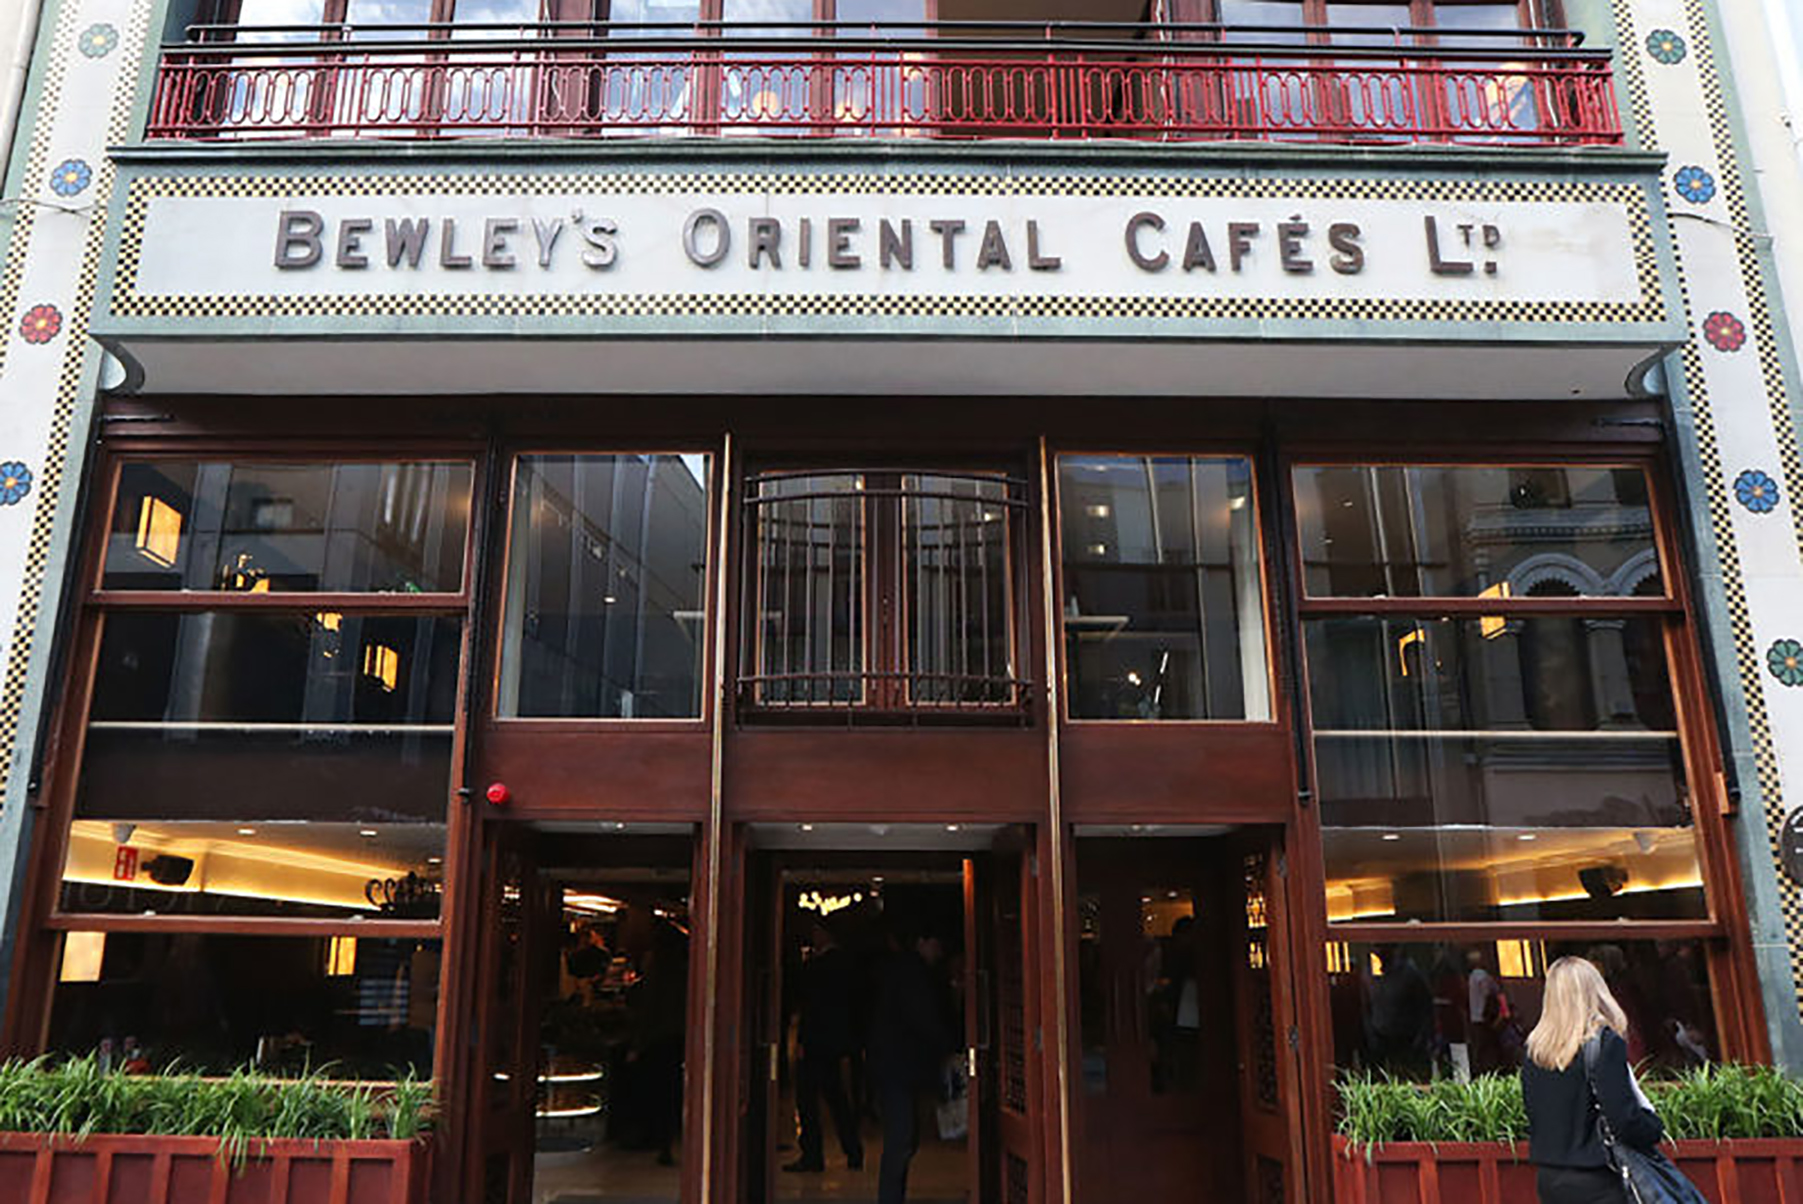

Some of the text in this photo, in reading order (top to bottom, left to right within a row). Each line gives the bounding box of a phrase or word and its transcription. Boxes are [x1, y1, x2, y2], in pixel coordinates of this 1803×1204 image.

[275, 209, 619, 270] BEWLEY'S
[682, 207, 1061, 271] ORIENTAL
[1124, 211, 1365, 274] CAFÉS
